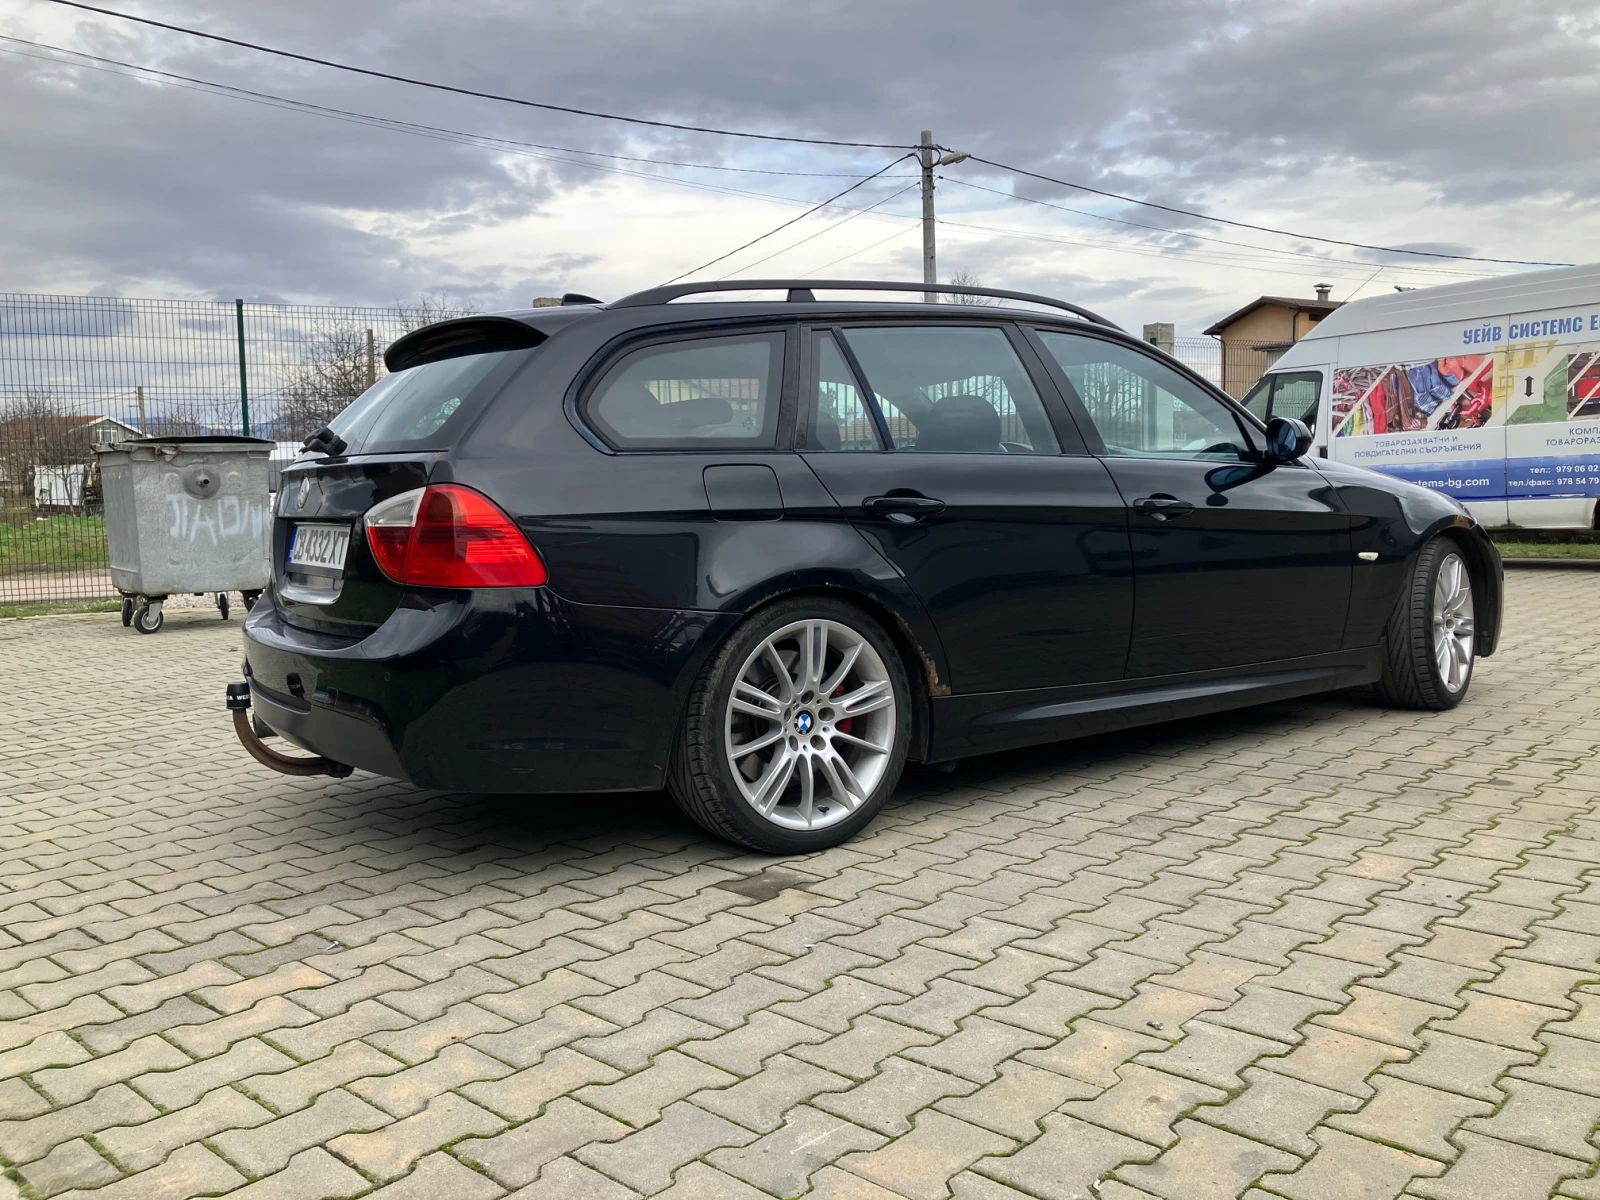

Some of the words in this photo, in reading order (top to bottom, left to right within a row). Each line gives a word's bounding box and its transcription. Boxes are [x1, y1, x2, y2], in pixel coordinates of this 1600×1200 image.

[1463, 323, 1502, 345] УЕЙВ
[1509, 316, 1583, 340] СИСТЕМС
[1590, 315, 1600, 331] Е
[1569, 426, 1600, 436] КОМП
[1375, 437, 1450, 448] ТОВАРОЗАХВАТНИ
[1354, 448, 1417, 458] ПОВДИГАТЕЛНИ
[1419, 443, 1482, 454] СЪОРЪЖЕНИЯ
[1556, 465, 1572, 473] 979
[1574, 465, 1586, 473] 06
[1588, 464, 1599, 472] 02
[1557, 478, 1573, 486] 978
[1575, 477, 1587, 485] 54
